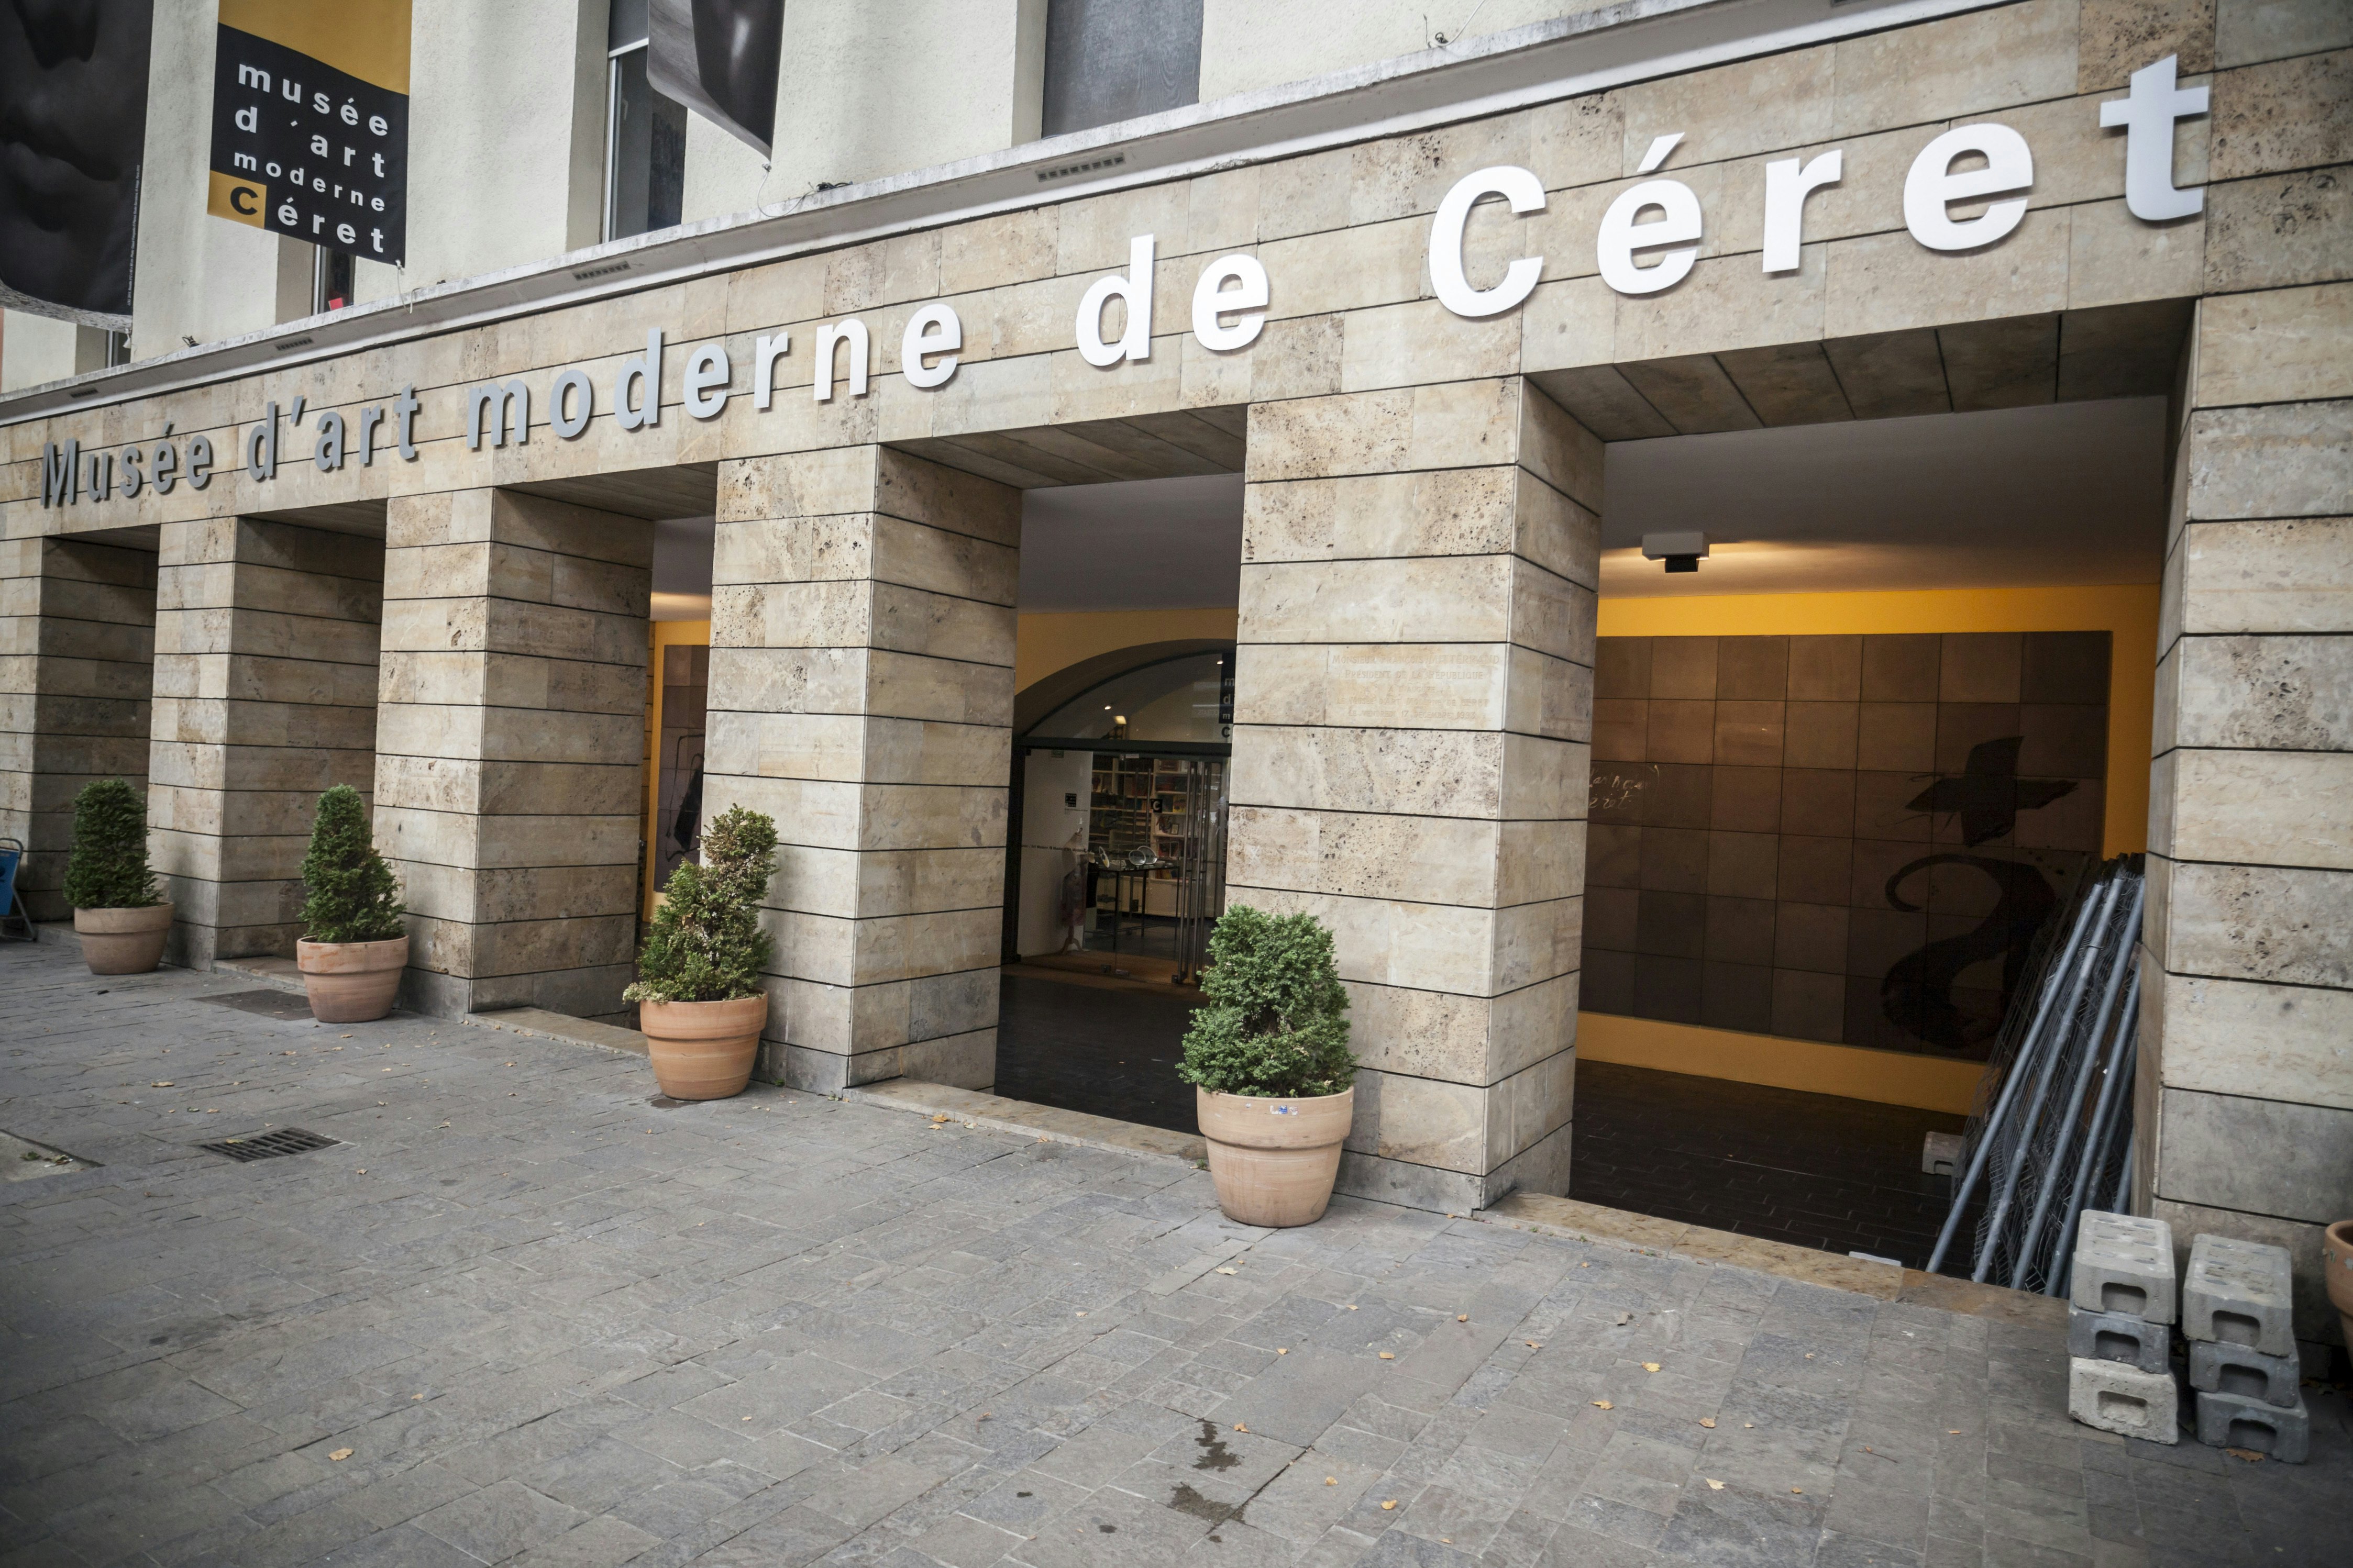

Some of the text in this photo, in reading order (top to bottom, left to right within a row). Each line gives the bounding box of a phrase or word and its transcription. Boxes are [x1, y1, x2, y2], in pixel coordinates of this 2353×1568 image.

[238, 63, 388, 137] musée
[234, 152, 385, 212] moderne
[40, 53, 2210, 507] Musée d'art moderne de Céret
